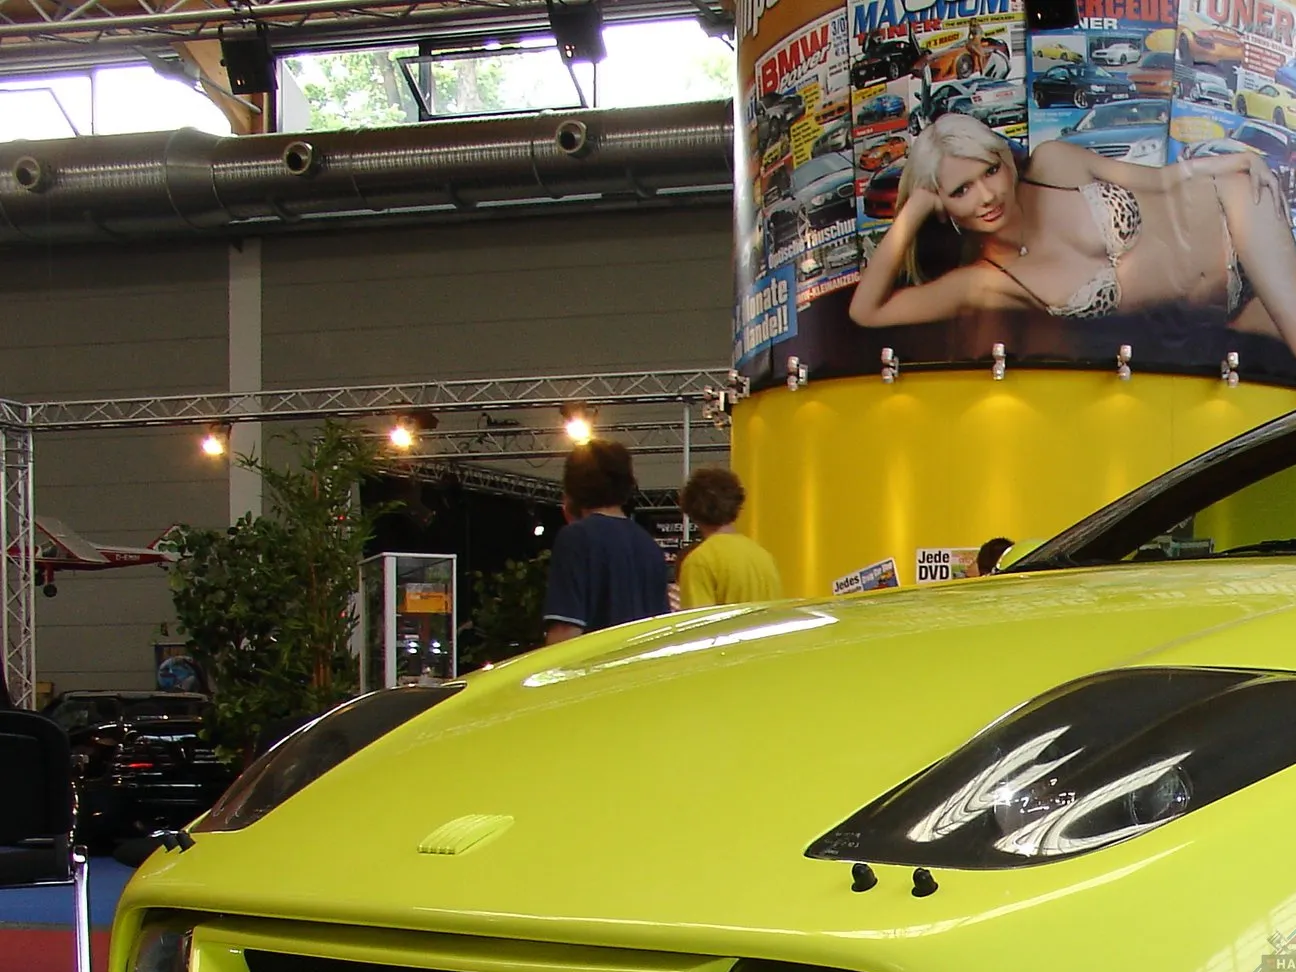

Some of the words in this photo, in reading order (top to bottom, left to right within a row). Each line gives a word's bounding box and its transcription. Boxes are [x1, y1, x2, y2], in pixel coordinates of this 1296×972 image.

[856, 18, 943, 46] TNER
[761, 24, 829, 95] BMW
[918, 550, 950, 564] Jede
[919, 565, 950, 581] DVD
[834, 575, 860, 593] Jedes
